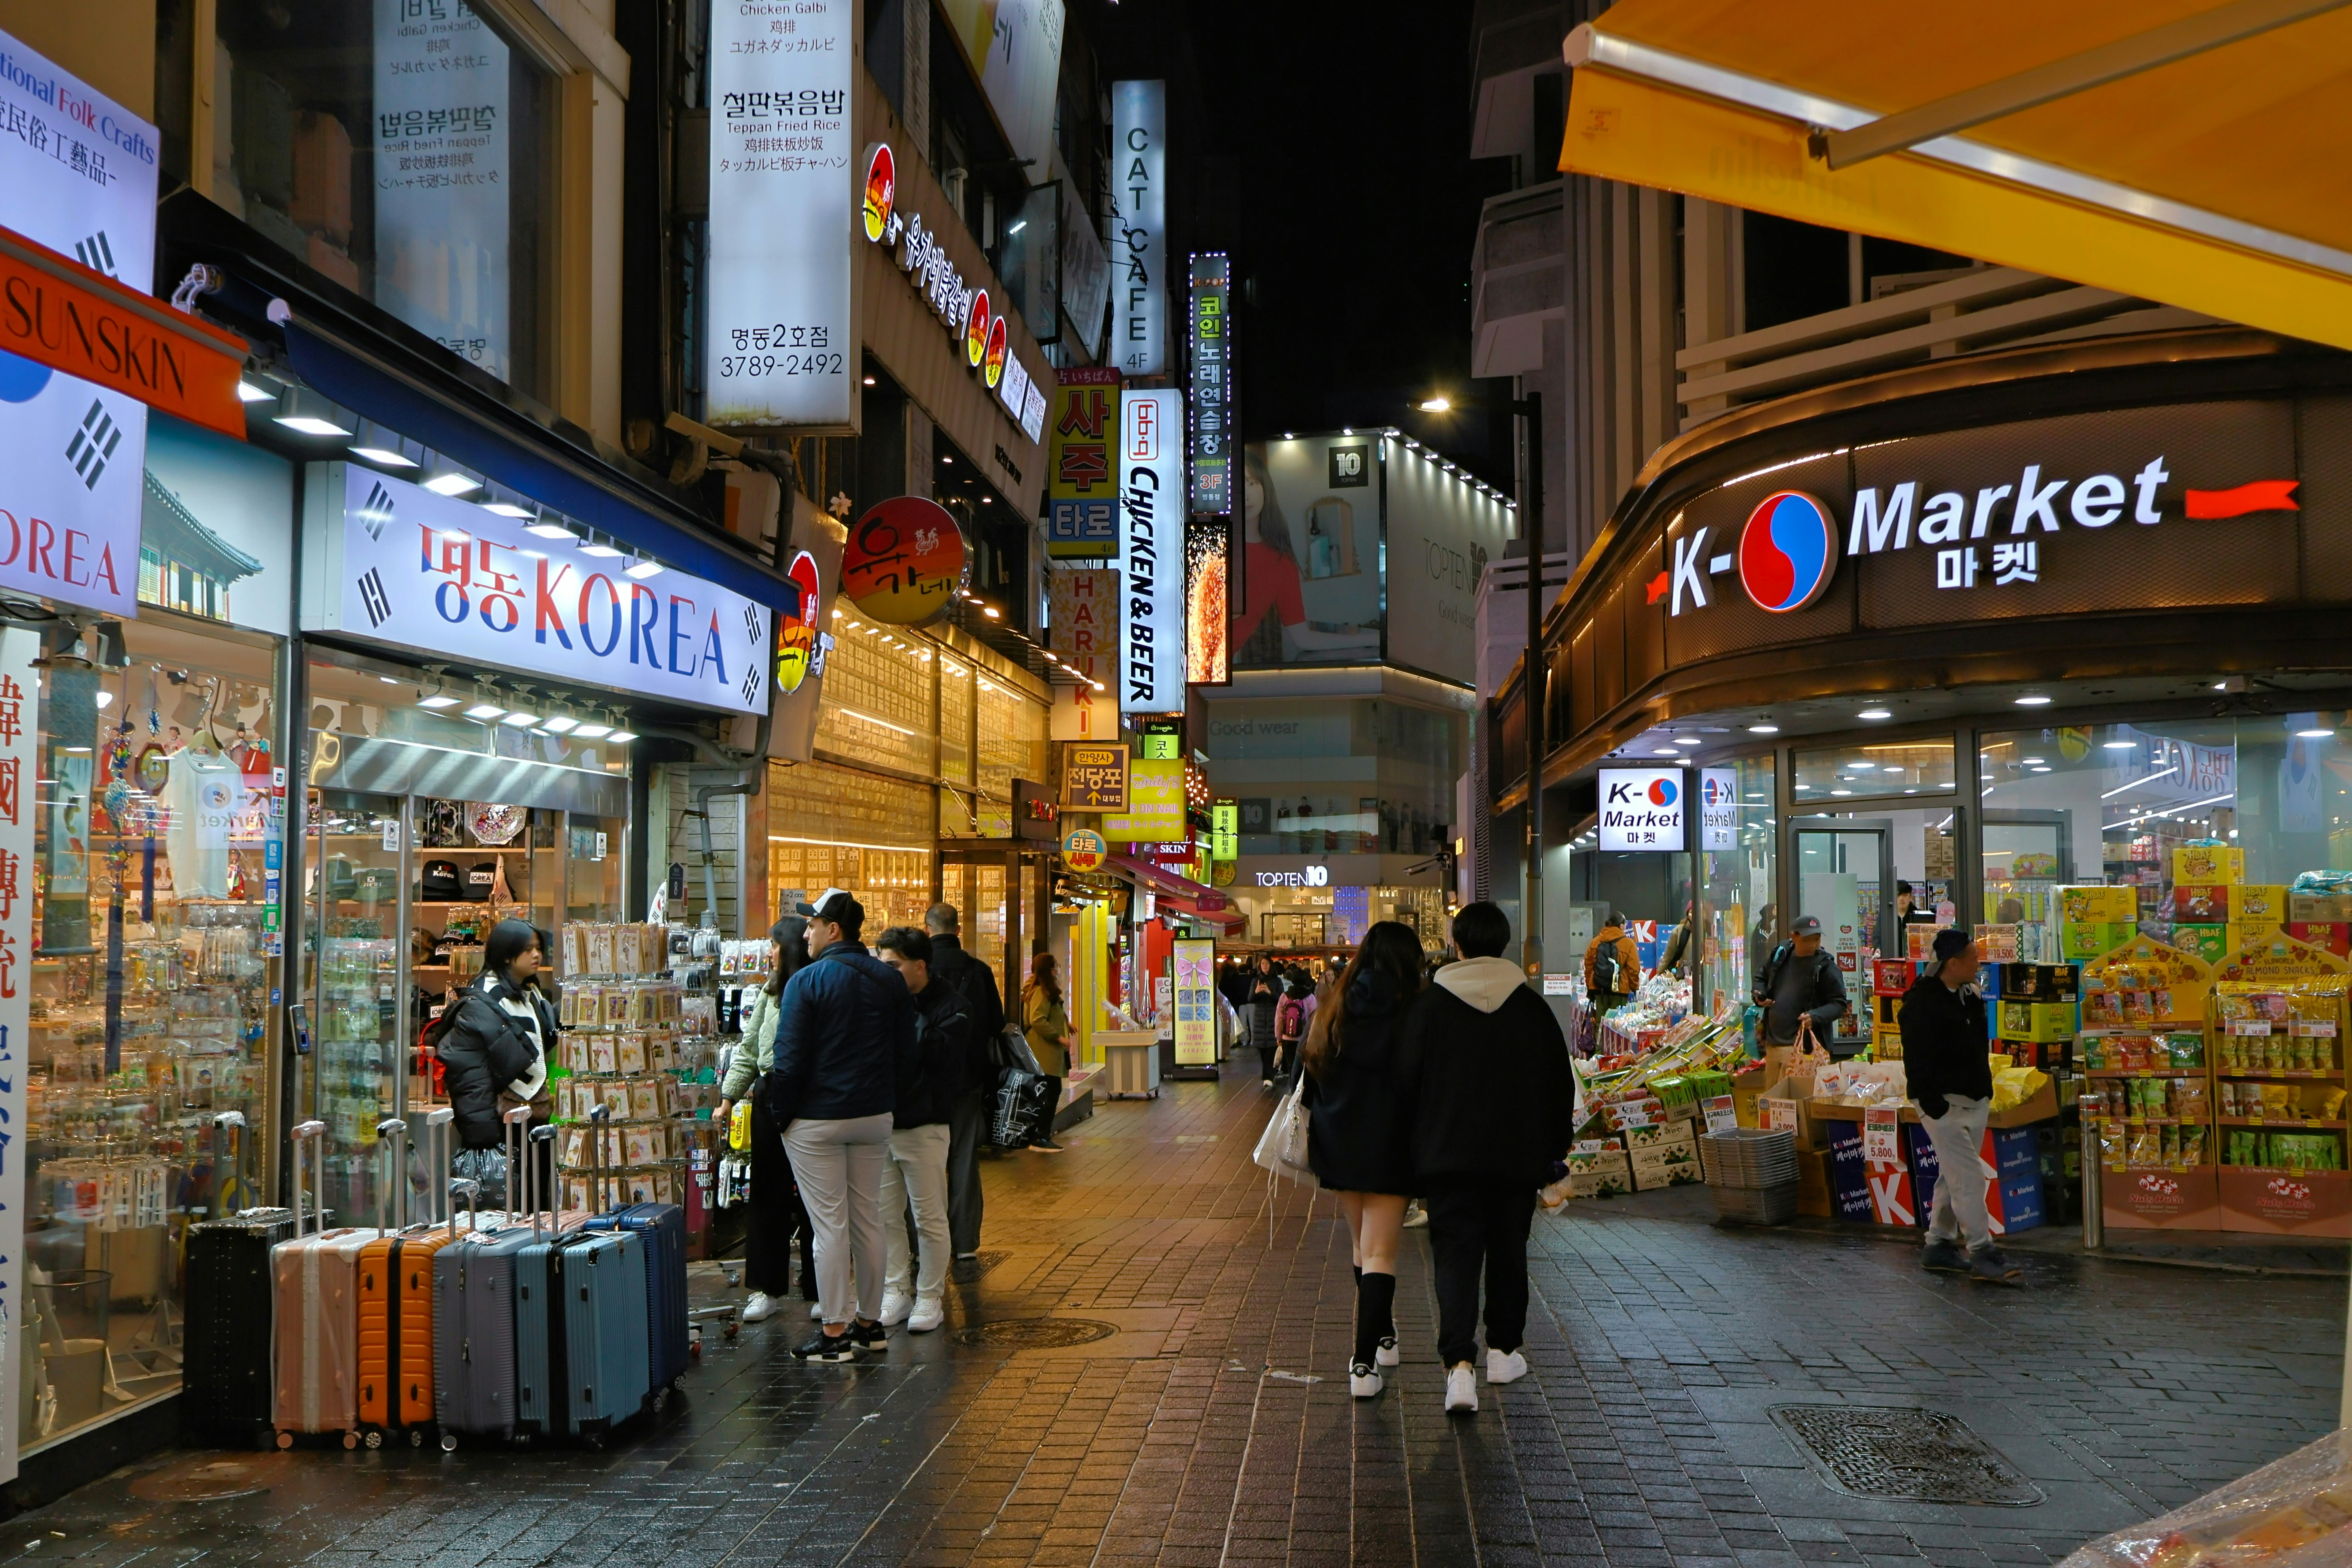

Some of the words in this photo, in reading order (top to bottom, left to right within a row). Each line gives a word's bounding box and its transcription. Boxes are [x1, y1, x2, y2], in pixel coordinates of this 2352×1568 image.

[740, 4, 790, 16] Chicken
[795, 2, 827, 14] Galbi
[770, 20, 796, 34] 鸡排
[730, 37, 835, 54] ユガネダッカルビ
[723, 89, 846, 118] 철판볶음밥
[59, 87, 97, 133] Folk
[101, 116, 154, 165] Crafts
[727, 122, 771, 134] Teppan
[777, 120, 808, 132] Fried
[814, 120, 840, 130] Rice
[744, 136, 823, 152] 鸡排铁板炒饭
[1127, 128, 1149, 211] CAT
[1127, 228, 1149, 341] CAFE
[5, 276, 186, 402] SUNSKIN
[732, 324, 828, 351] 명동2호점
[720, 354, 842, 377] 3789-2492
[1126, 353, 1147, 368] 4F
[1059, 391, 1110, 489] 사주
[1336, 452, 1361, 477] 10
[1200, 474, 1222, 489] 3F
[1848, 455, 2169, 556] Market
[1055, 503, 1114, 538] 타로
[1100, 543, 1113, 553] 4F
[1936, 541, 2038, 589] 마켓
[1439, 600, 1457, 624] Good
[1074, 576, 1094, 732] HARUKI
[1209, 720, 1253, 737] Good
[1258, 721, 1299, 735] wear
[1078, 753, 1110, 763] 한양사
[1069, 768, 1122, 790] 전당포
[1608, 783, 1643, 804] K-
[1140, 804, 1154, 813] ON
[1157, 804, 1181, 813] NAIL
[1105, 820, 1130, 829] 네일팁
[1133, 819, 1181, 829] ネイルチップ
[1604, 811, 1680, 827] Market
[269, 824, 280, 833] VISA
[1071, 837, 1096, 851] 타로
[1628, 832, 1655, 843] 마켓
[1160, 845, 1187, 853] SKIN
[2189, 850, 2212, 859] HBAF
[1069, 852, 1096, 867] 사주
[1216, 861, 1229, 869] 미래
[433, 870, 454, 878] Korea
[1256, 866, 1328, 887] TOPTEN10
[673, 881, 678, 896] 8
[2087, 891, 2105, 900] HBAF
[2190, 888, 2212, 897] HBAF
[2244, 886, 2268, 897] HBAF
[893, 893, 906, 904] SALE
[1635, 920, 1656, 942] K
[2077, 924, 2096, 933] HBAF
[2200, 928, 2220, 937] HBAF
[2242, 924, 2265, 935] HBAF
[2307, 924, 2332, 934] HBAF
[1994, 948, 2013, 960] 19,500
[1839, 955, 1854, 968] 떡신
[2054, 966, 2069, 976] HBAF
[2246, 966, 2280, 975] ALMOND
[2284, 966, 2315, 975] SNACKS
[2050, 1005, 2065, 1015] HBAF
[2048, 1044, 2062, 1054] HBAF
[1825, 1082, 1838, 1090] Milk
[1843, 1136, 1862, 1147] Market
[2010, 1131, 2027, 1140] Market
[1850, 1188, 1869, 1198] Market
[2018, 1185, 2034, 1195] Market
[1843, 1197, 1873, 1212] 케이마켓
[1870, 1173, 1915, 1225] K
[2129, 1193, 2154, 1203] Nuts
[2255, 1197, 2283, 1207] Nuts
